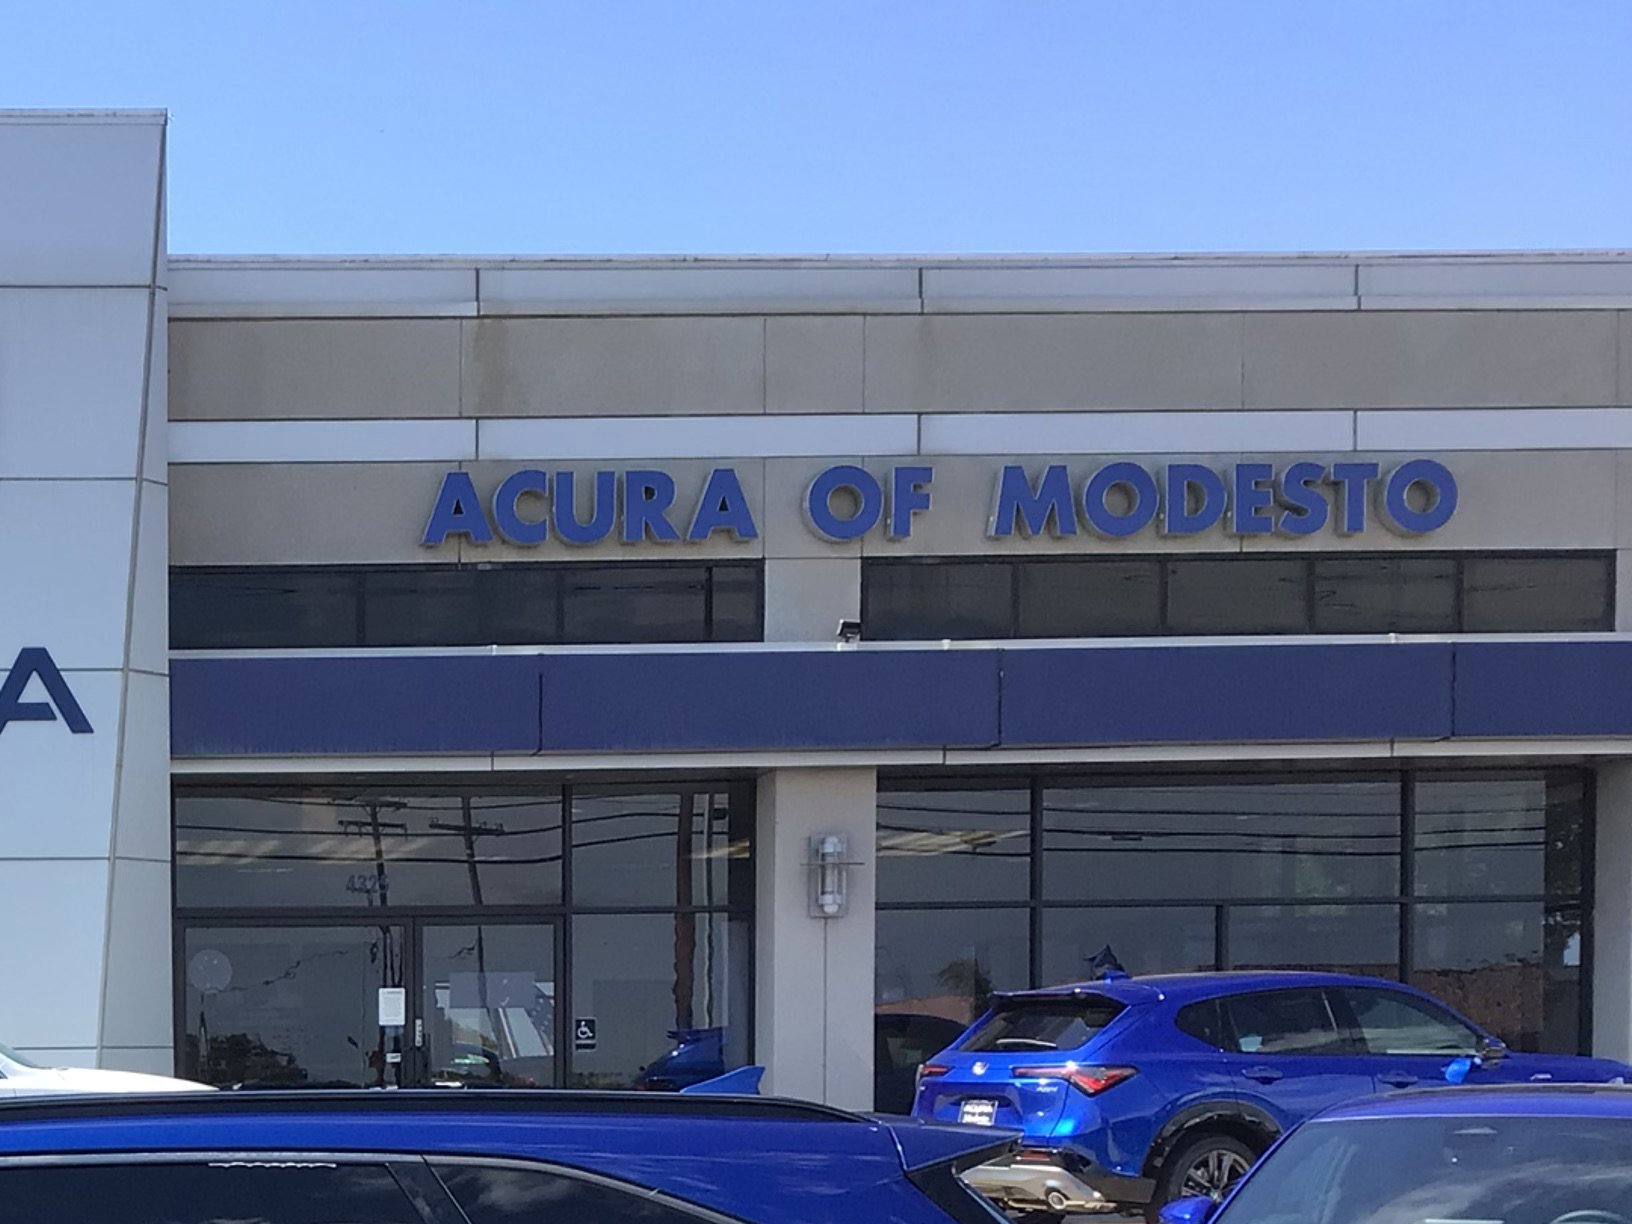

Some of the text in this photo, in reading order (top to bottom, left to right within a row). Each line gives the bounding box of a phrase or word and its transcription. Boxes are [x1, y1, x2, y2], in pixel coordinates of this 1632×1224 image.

[422, 459, 1459, 545] ACURA OF MODESTO
